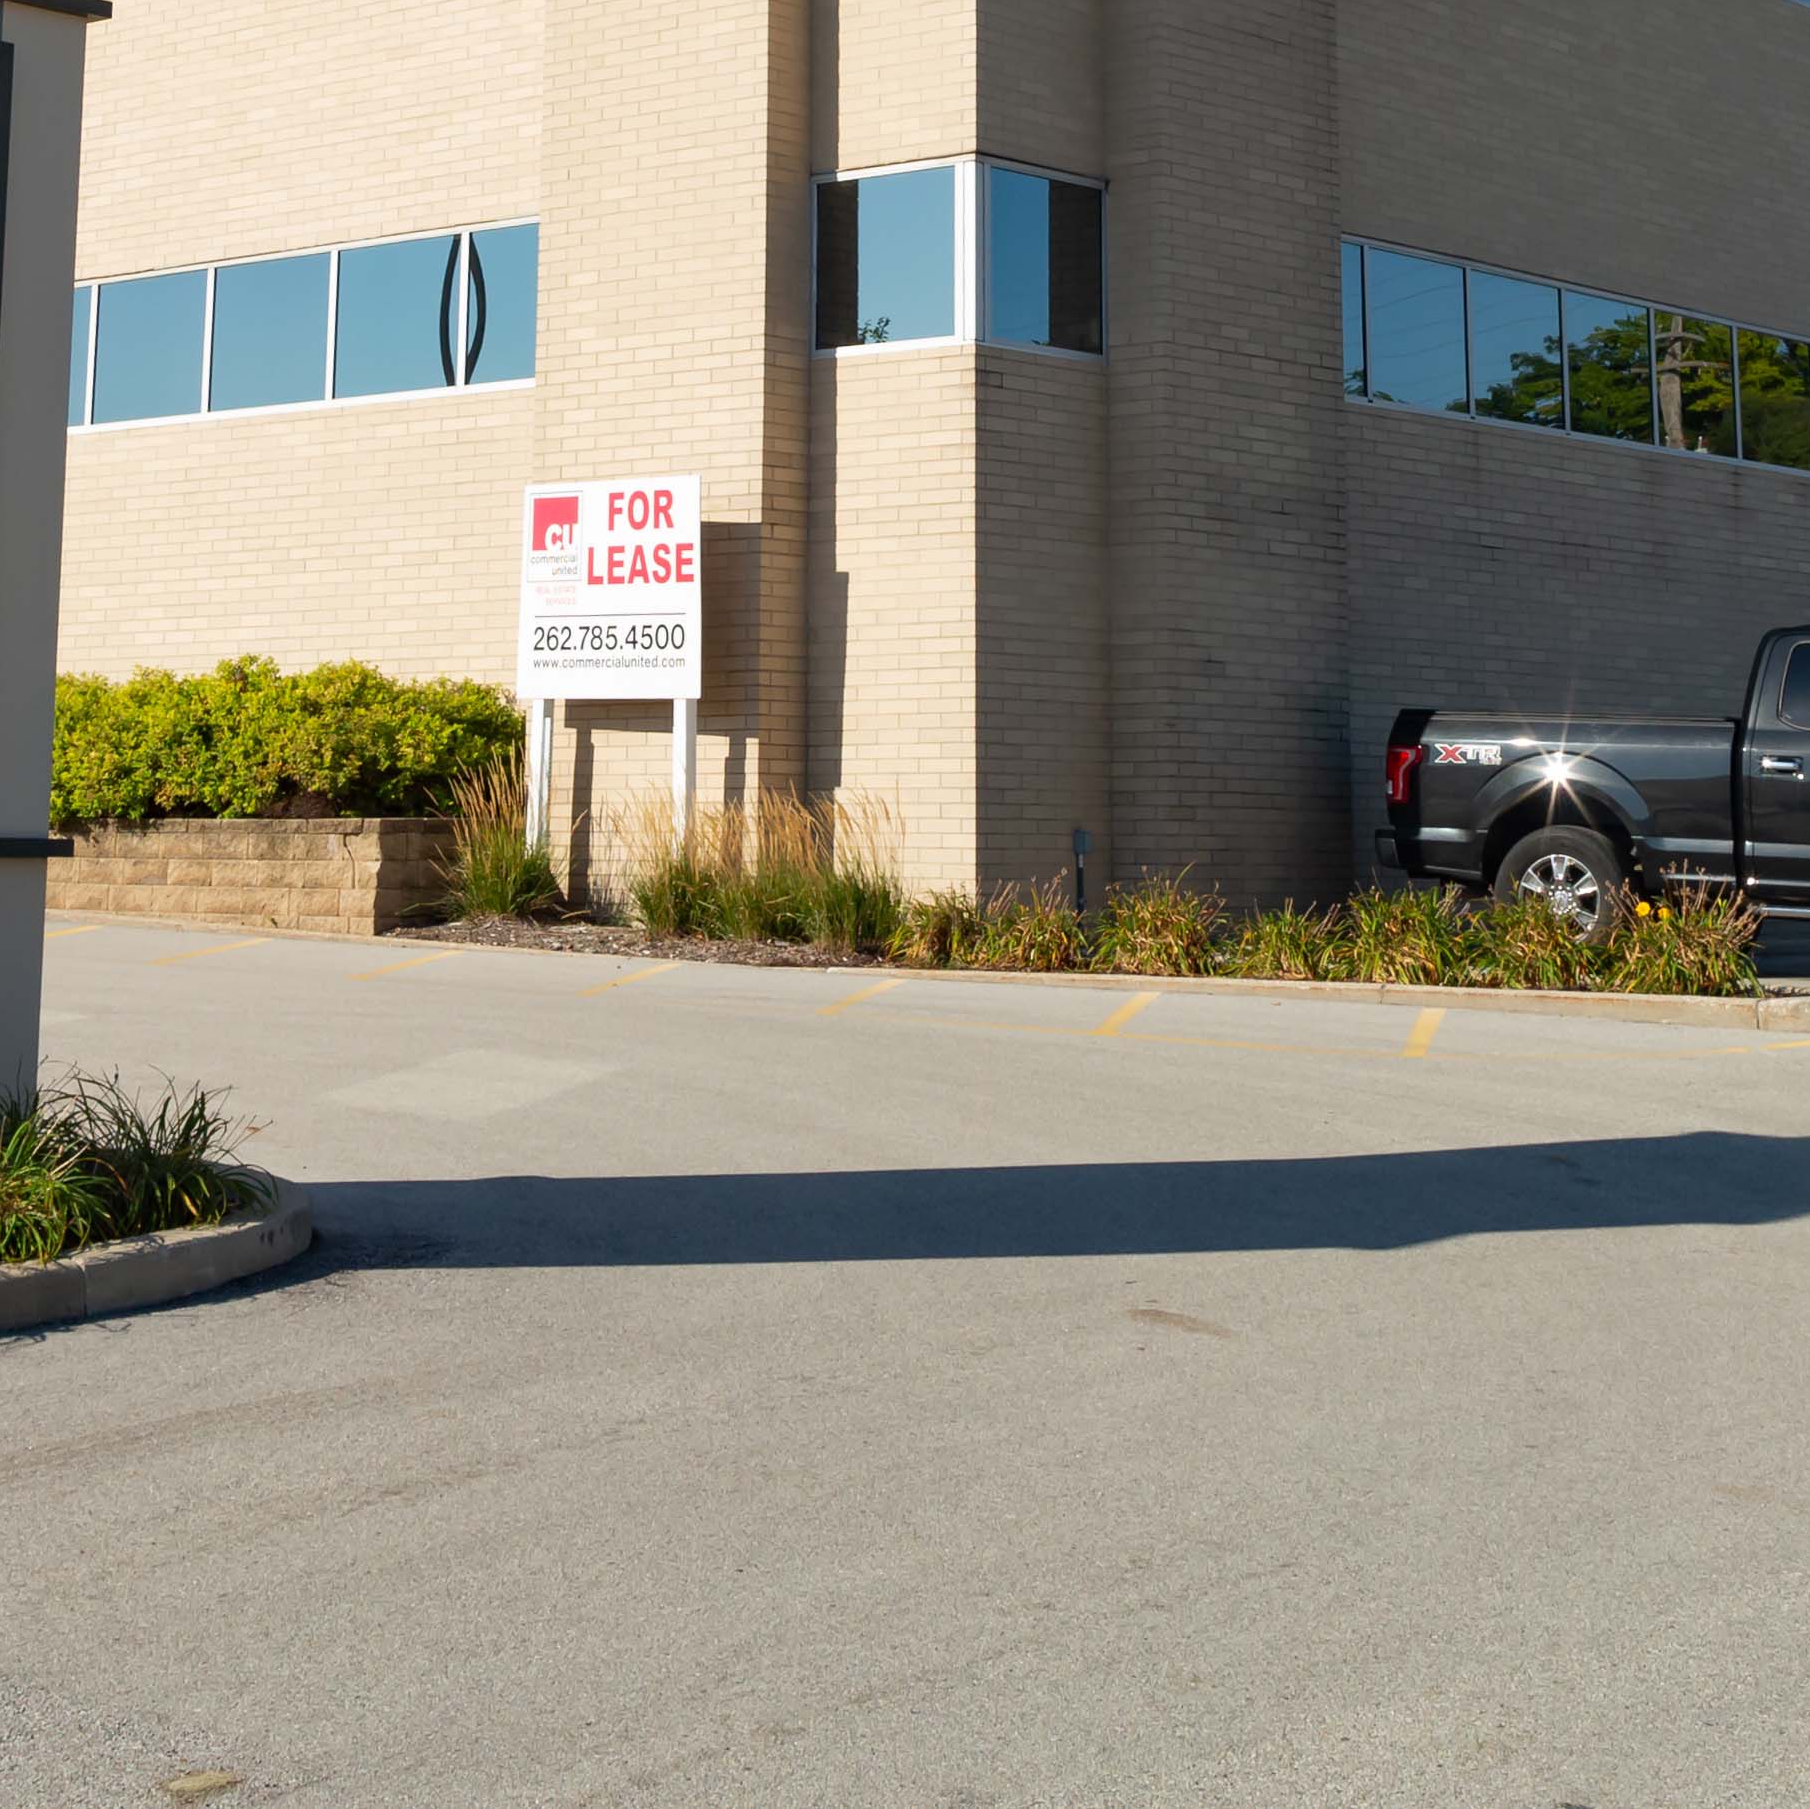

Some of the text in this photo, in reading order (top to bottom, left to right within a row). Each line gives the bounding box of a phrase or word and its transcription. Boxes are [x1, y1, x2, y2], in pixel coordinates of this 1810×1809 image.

[608, 490, 674, 531] FOR
[552, 566, 578, 576] united
[587, 543, 694, 585] LEASE
[533, 624, 685, 651] 262.785.4500
[533, 656, 685, 669] www.commercialunited.com
